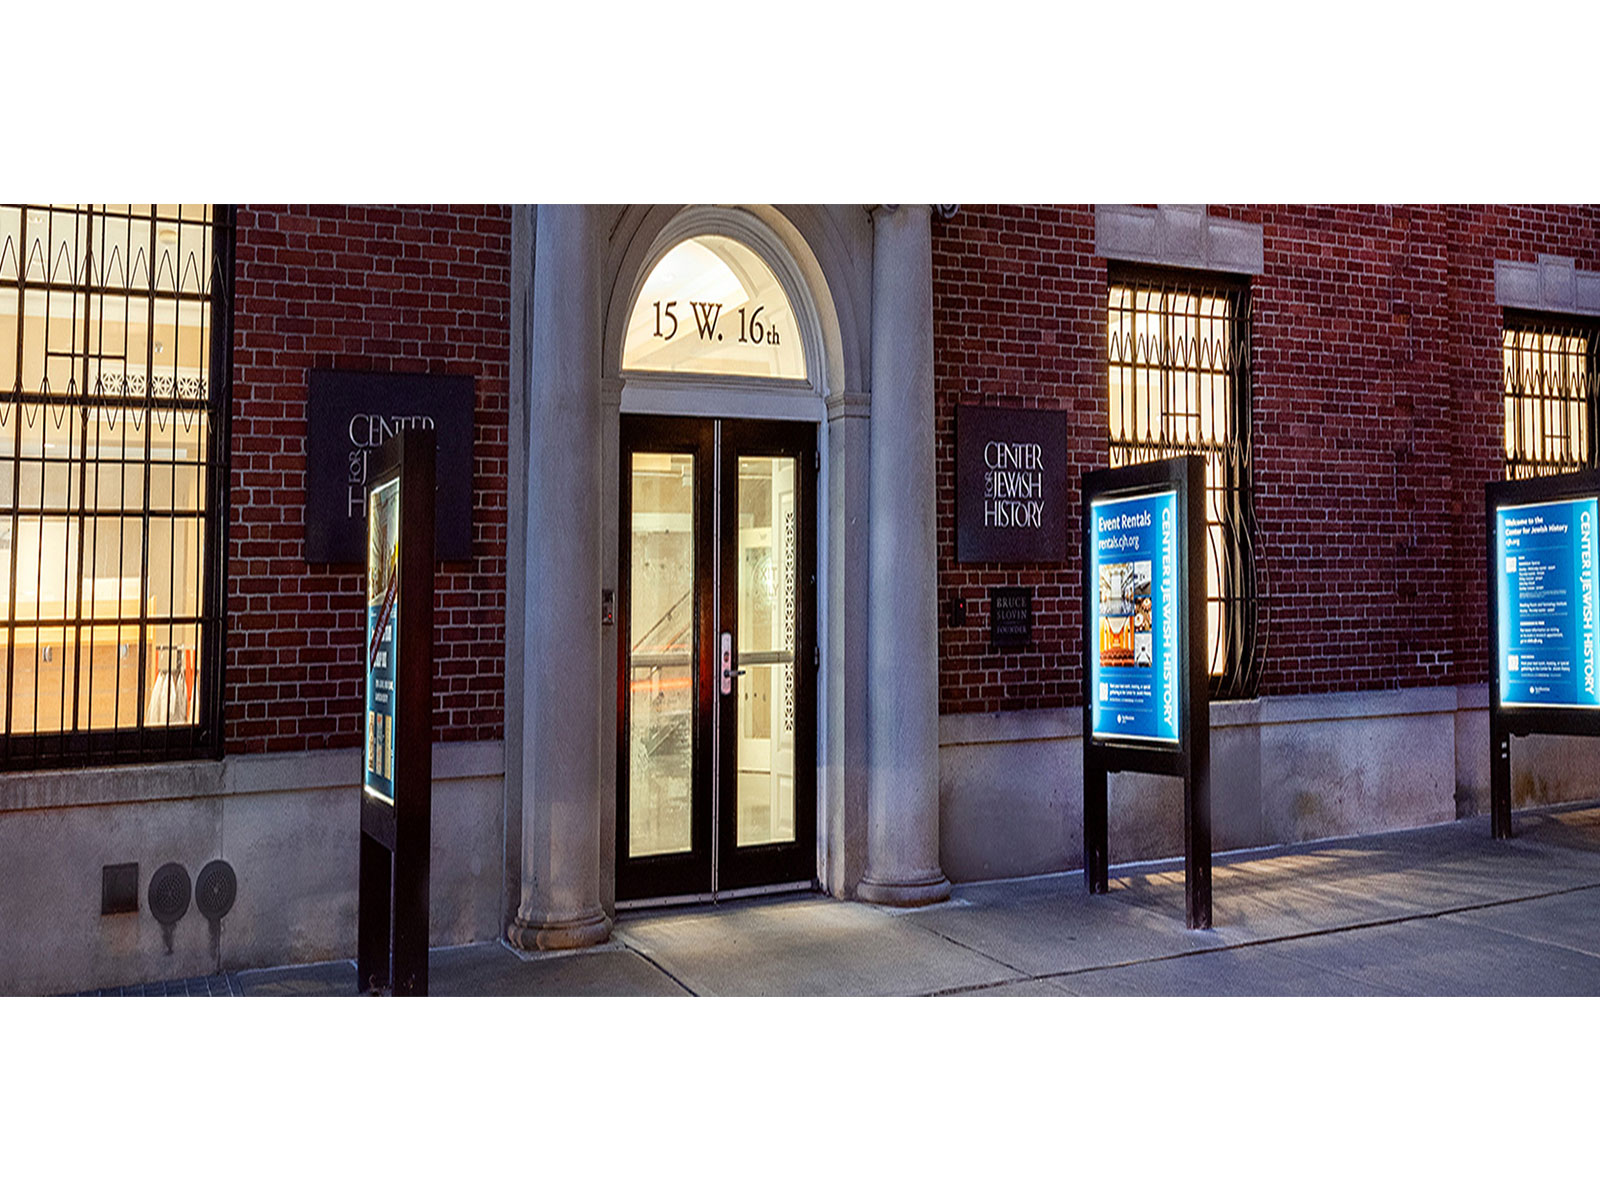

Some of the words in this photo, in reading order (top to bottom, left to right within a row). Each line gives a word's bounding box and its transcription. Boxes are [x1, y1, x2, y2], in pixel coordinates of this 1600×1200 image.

[653, 301, 678, 341] 15
[690, 301, 723, 342] W.
[738, 305, 780, 346] 16th
[984, 440, 1043, 471] CENTER
[993, 471, 1042, 500] JEWISH
[984, 500, 1045, 529] HISTORY
[1098, 516, 1120, 532] Event
[1121, 510, 1151, 529] Rentals
[1162, 507, 1171, 575] CENTER
[1580, 511, 1591, 569] CENTER
[996, 596, 1027, 608] BRUCE
[1160, 585, 1171, 648] JEWISH
[1579, 576, 1592, 629] JEWISH
[1162, 652, 1172, 726] HISTORY
[1583, 633, 1595, 696] HISTORY
